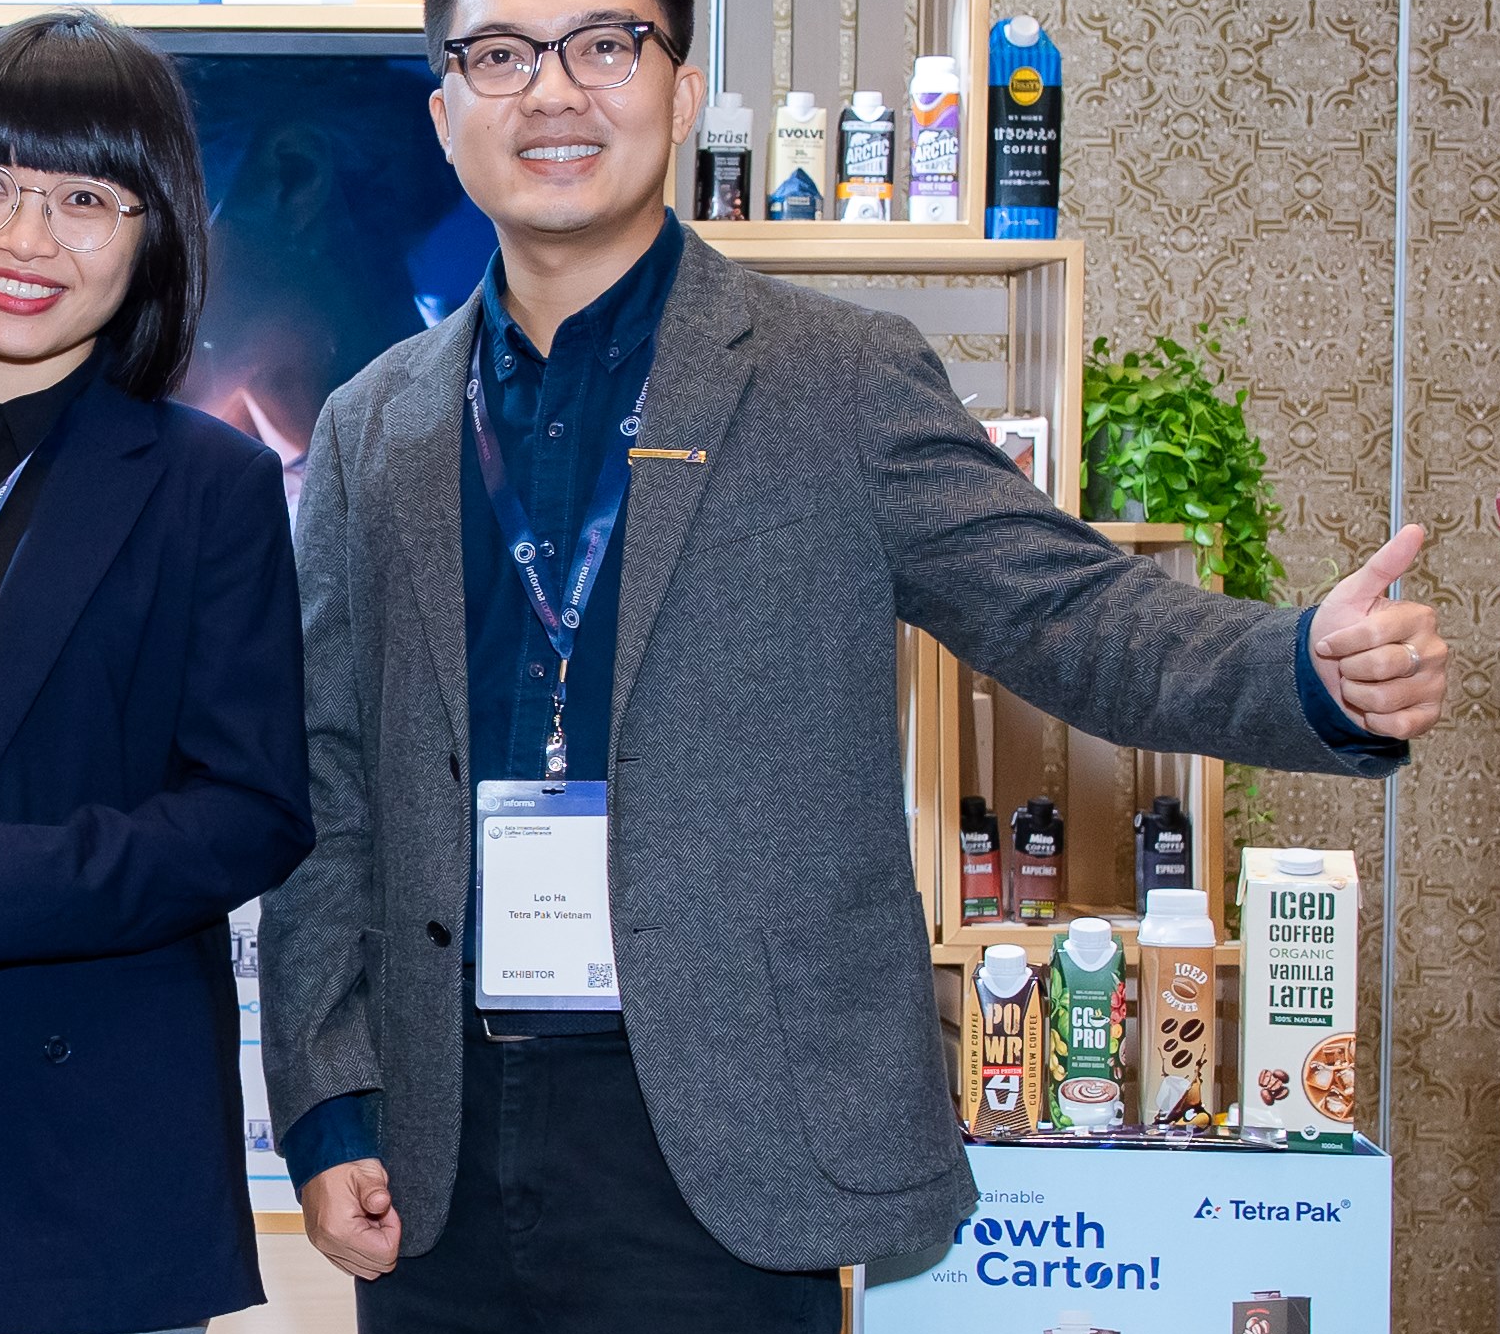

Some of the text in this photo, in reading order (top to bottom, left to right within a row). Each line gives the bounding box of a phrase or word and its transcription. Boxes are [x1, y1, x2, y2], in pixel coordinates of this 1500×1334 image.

[707, 130, 748, 144] brüst
[778, 128, 824, 139] EVOLVE
[846, 138, 890, 165] ARCTIC
[915, 136, 959, 163] ARCTIC
[1002, 145, 1048, 154] COFFEE
[525, 565, 546, 602] informa
[570, 566, 590, 606] informa
[504, 799, 535, 807] informa
[534, 894, 566, 902] Leo Ha
[509, 911, 592, 919] Tetra Pak Vietnam
[1269, 947, 1335, 959] ORGANIC
[502, 970, 555, 979] EXHIBITOR
[1174, 962, 1208, 985] ICED
[1161, 990, 1199, 1013] COFFEE
[971, 1013, 979, 1042] COFFEE
[1274, 1016, 1292, 1024] 100%
[1030, 1015, 1038, 1048] COFFEE
[1072, 1028, 1106, 1049] PRO
[1029, 1082, 1037, 1106] COLD
[1229, 1199, 1290, 1221] Tetra
[931, 1251, 1161, 1291] with Carton!
